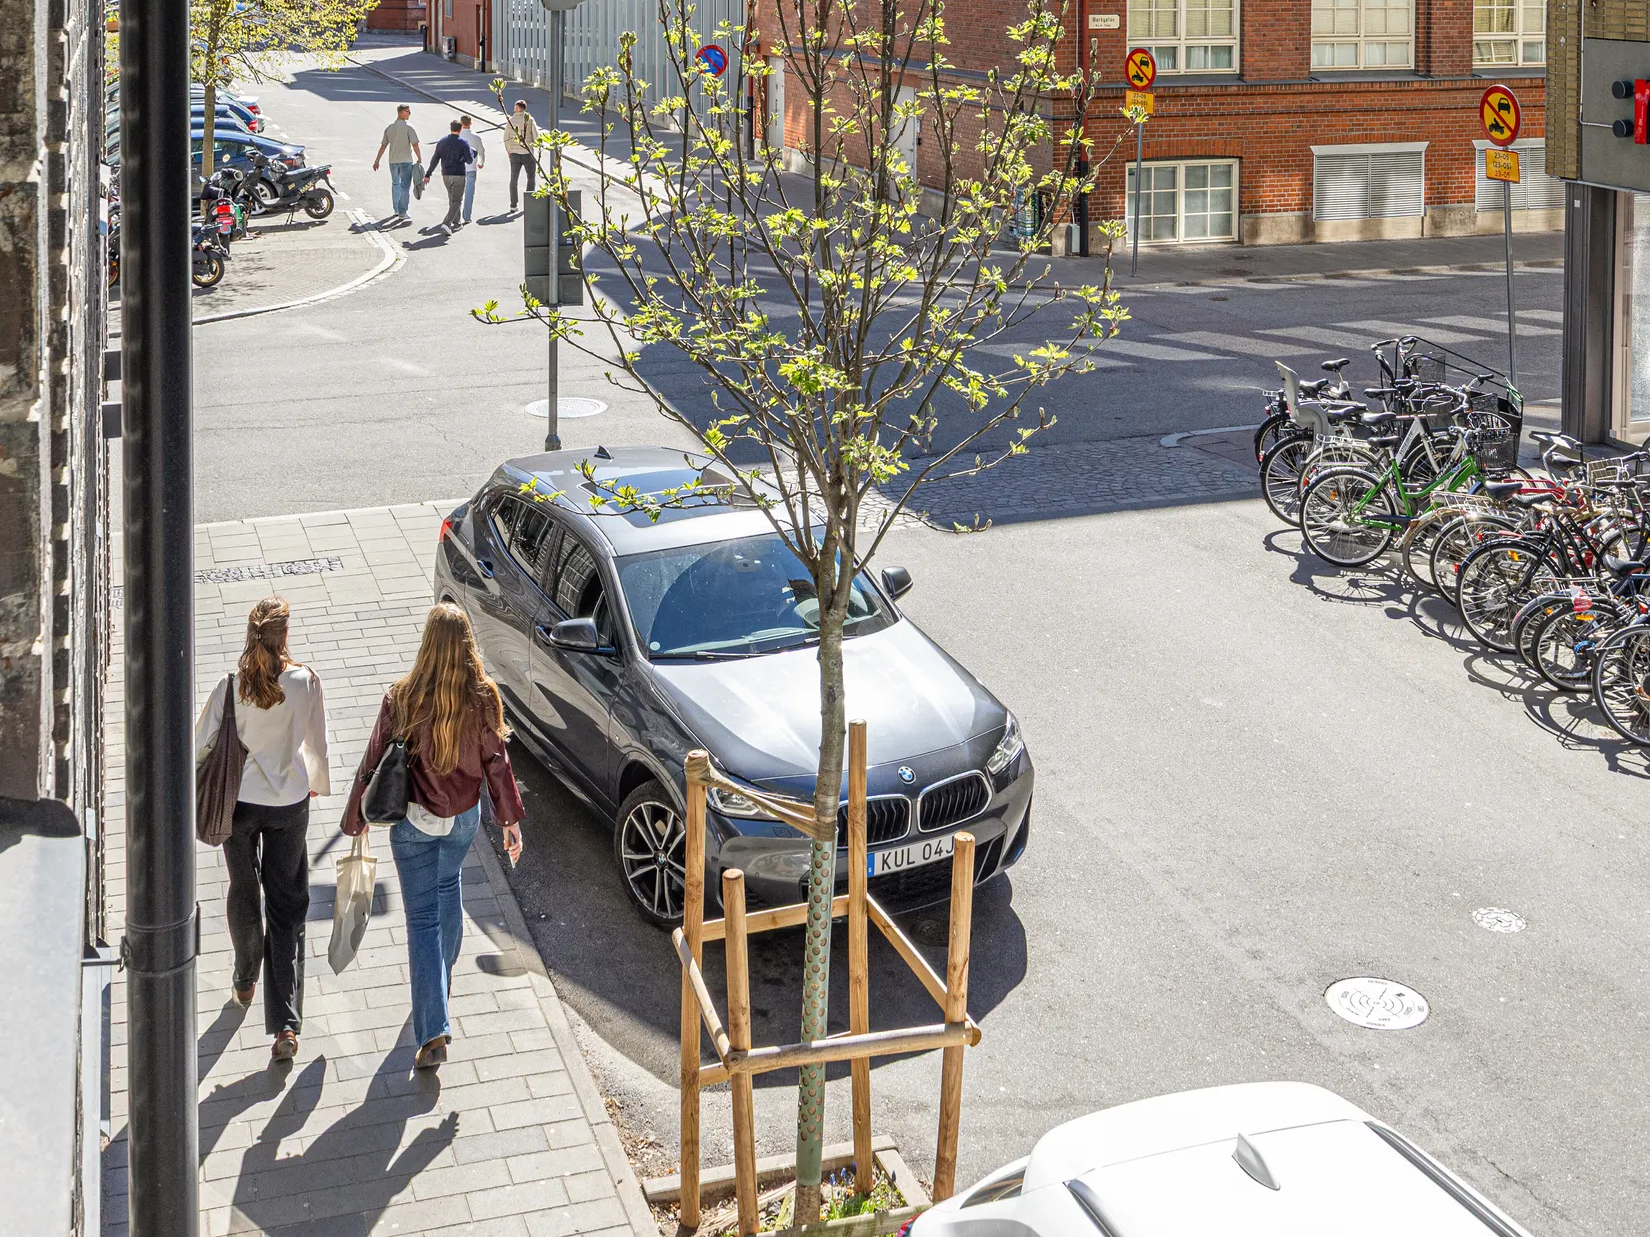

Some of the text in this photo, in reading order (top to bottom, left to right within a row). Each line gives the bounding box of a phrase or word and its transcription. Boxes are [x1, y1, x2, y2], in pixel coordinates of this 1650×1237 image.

[1493, 152, 1509, 160] 23-05
[1492, 160, 1512, 170] (23-05)
[1494, 170, 1510, 178] 23-05
[881, 847, 915, 871] KUL
